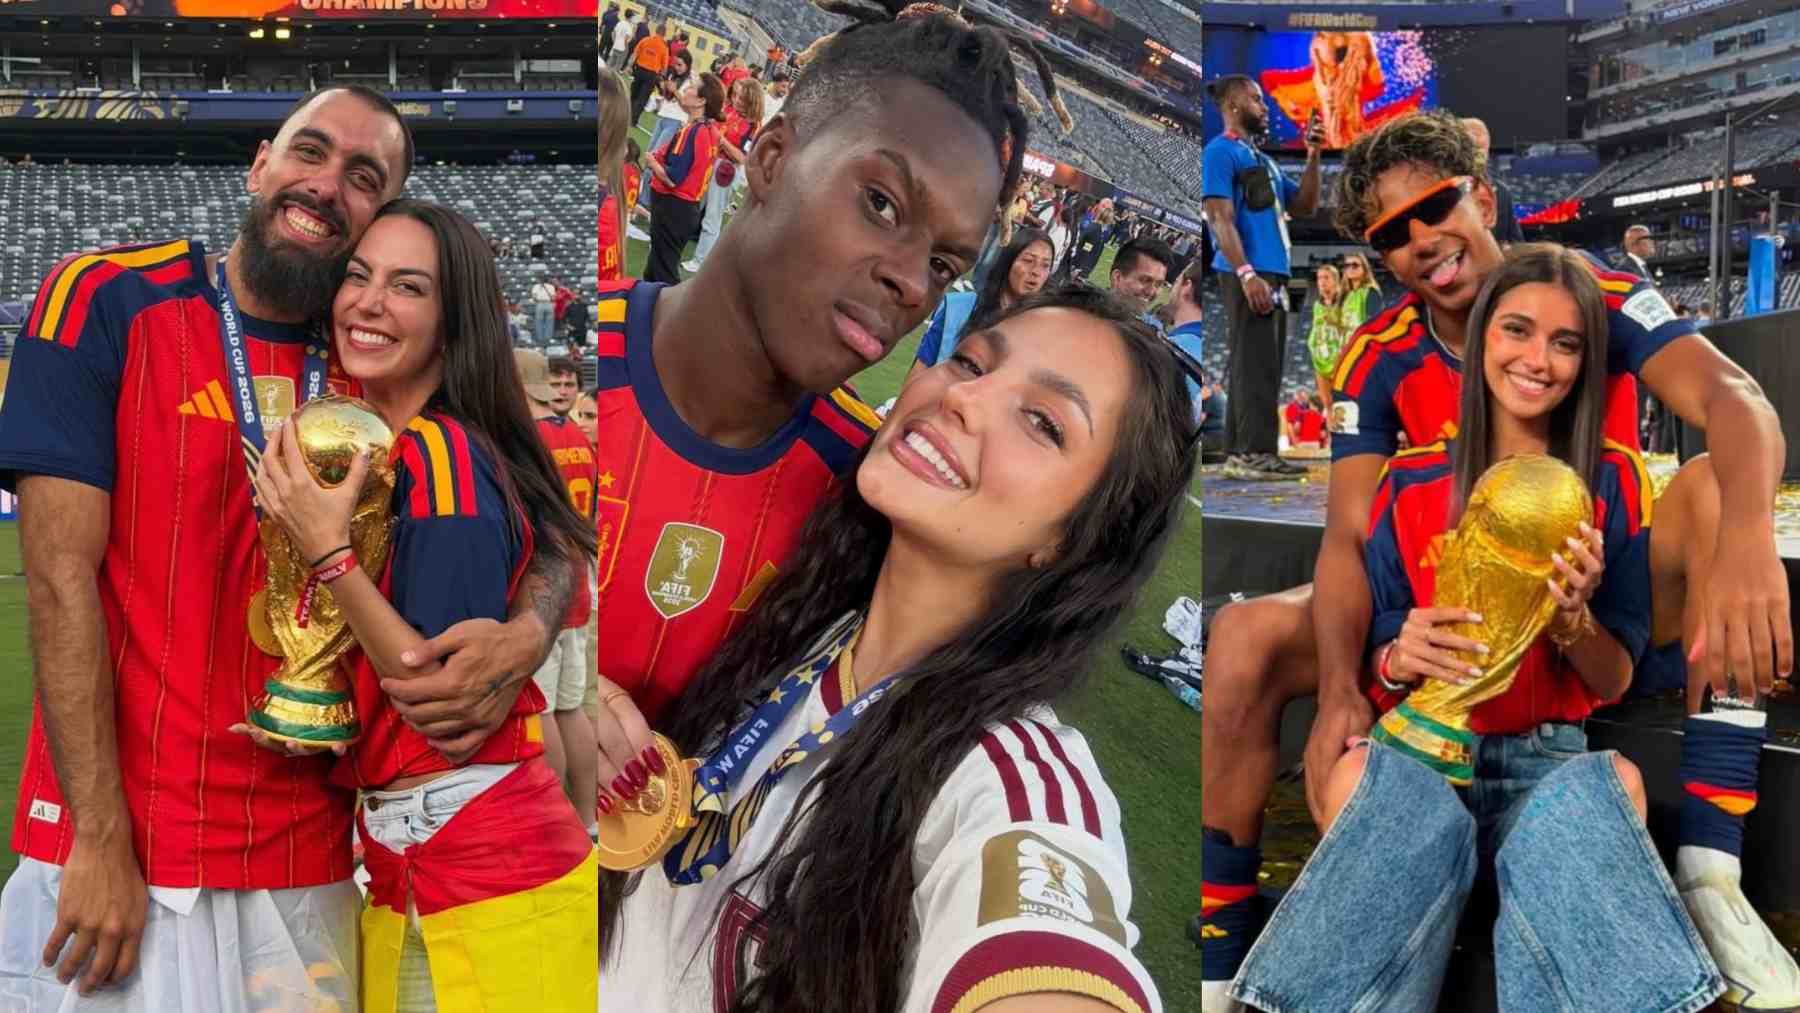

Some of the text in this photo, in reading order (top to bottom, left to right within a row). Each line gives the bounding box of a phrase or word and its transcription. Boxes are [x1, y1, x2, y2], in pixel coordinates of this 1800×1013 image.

[220, 300, 240, 346] WORLD
[231, 347, 246, 374] CUP
[237, 374, 255, 424] 2026
